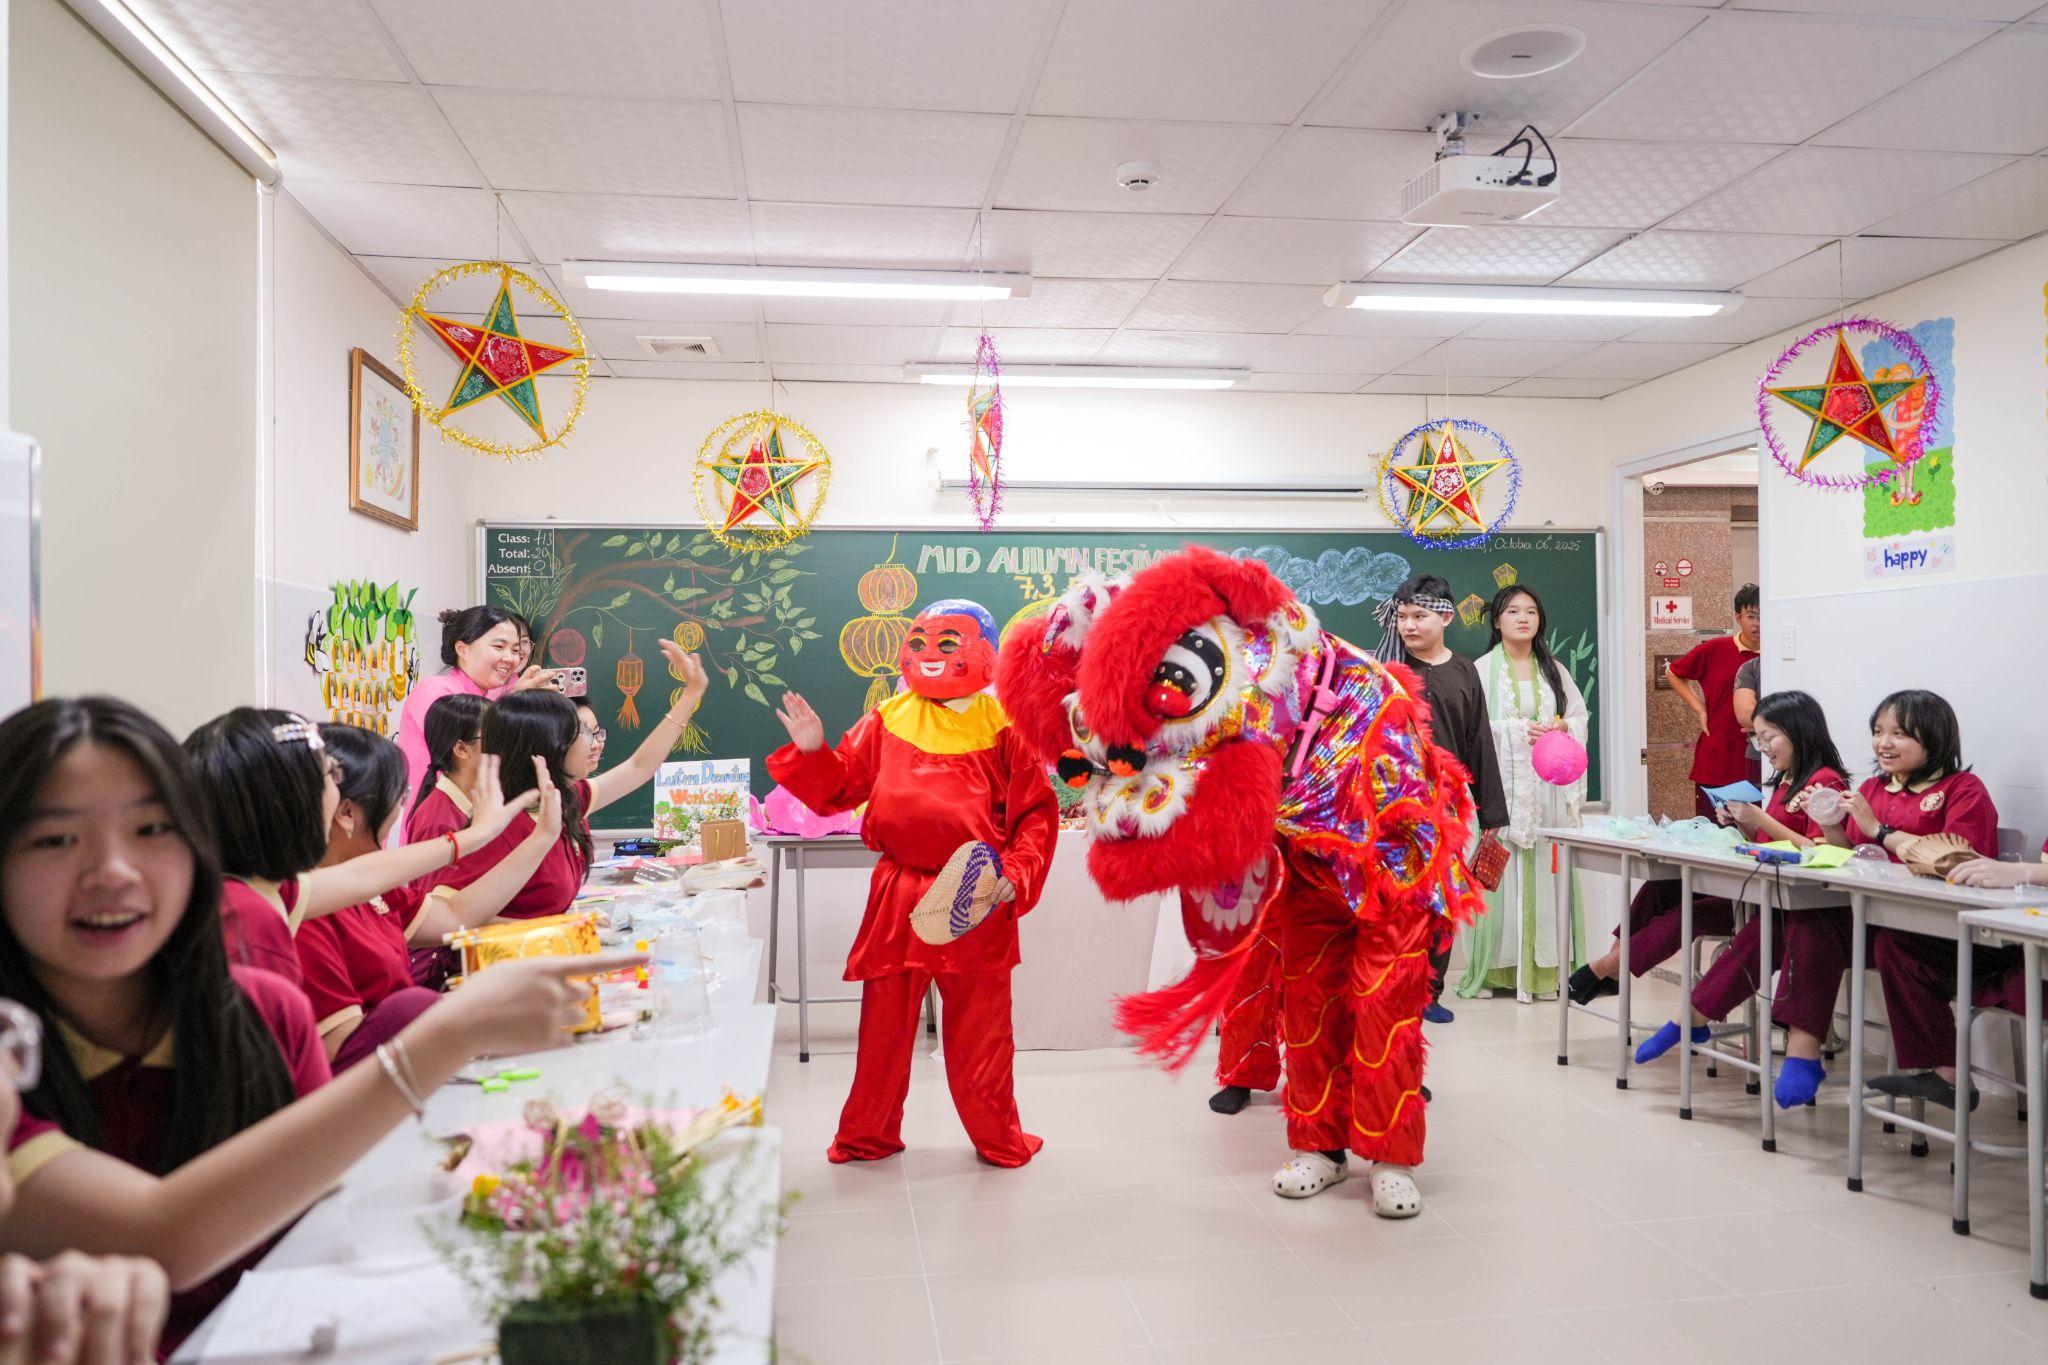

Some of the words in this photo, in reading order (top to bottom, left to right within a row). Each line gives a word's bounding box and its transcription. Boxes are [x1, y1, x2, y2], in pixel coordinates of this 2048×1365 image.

[498, 533, 530, 543] Class:
[1555, 540, 1582, 551] 2025
[499, 548, 530, 559] Total:
[916, 544, 981, 574] MID
[986, 546, 1090, 575] AUTUMN
[1884, 549, 1927, 570] happy
[488, 563, 531, 574] Absent:
[1653, 616, 1672, 624] Medical
[1673, 616, 1690, 624] Service
[656, 767, 700, 787] Lantern
